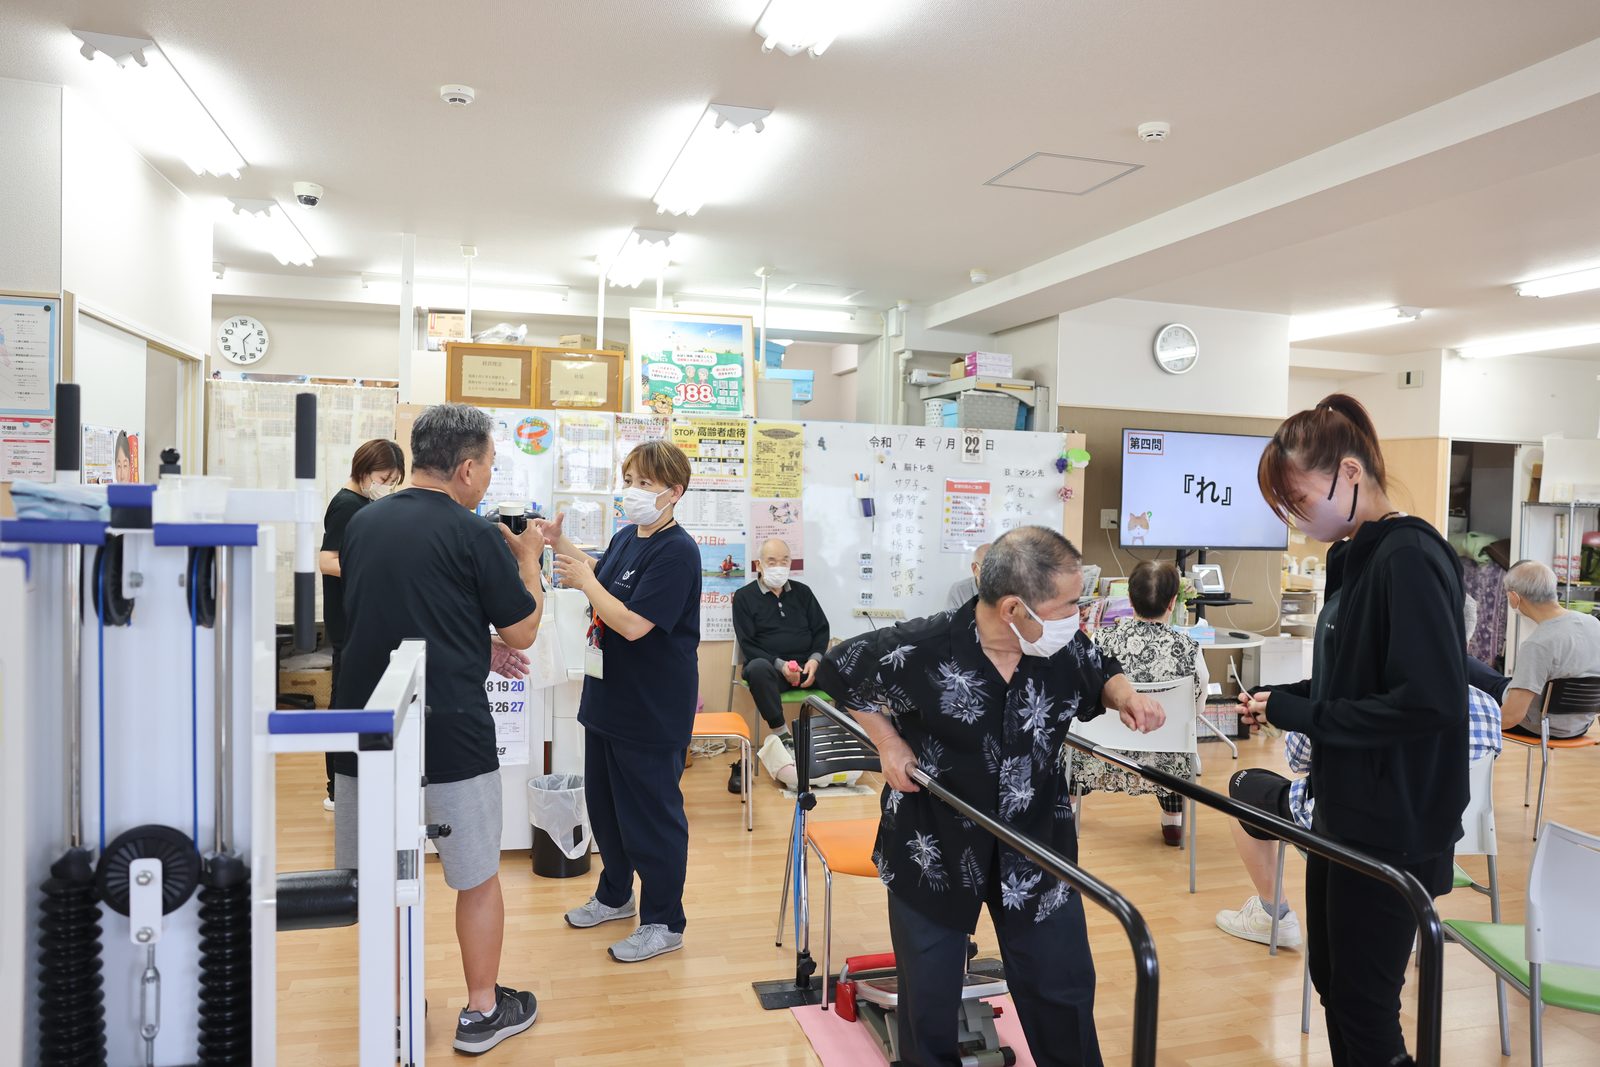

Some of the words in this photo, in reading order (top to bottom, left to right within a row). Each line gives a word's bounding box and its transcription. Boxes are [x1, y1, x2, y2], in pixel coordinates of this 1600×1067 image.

[674, 383, 714, 403] 188
[697, 426, 746, 438] 高齢者虐待
[869, 436, 892, 449] 令和
[915, 437, 927, 449] 年
[933, 436, 942, 452] 9
[946, 438, 956, 450] 月
[965, 436, 980, 453] 22
[985, 439, 995, 450] 日
[1130, 437, 1162, 451] 第四問
[1184, 474, 1231, 506] 『れ』
[496, 681, 509, 692] 19
[510, 681, 524, 692] 20
[495, 702, 509, 712] 26
[510, 702, 524, 712] 27
